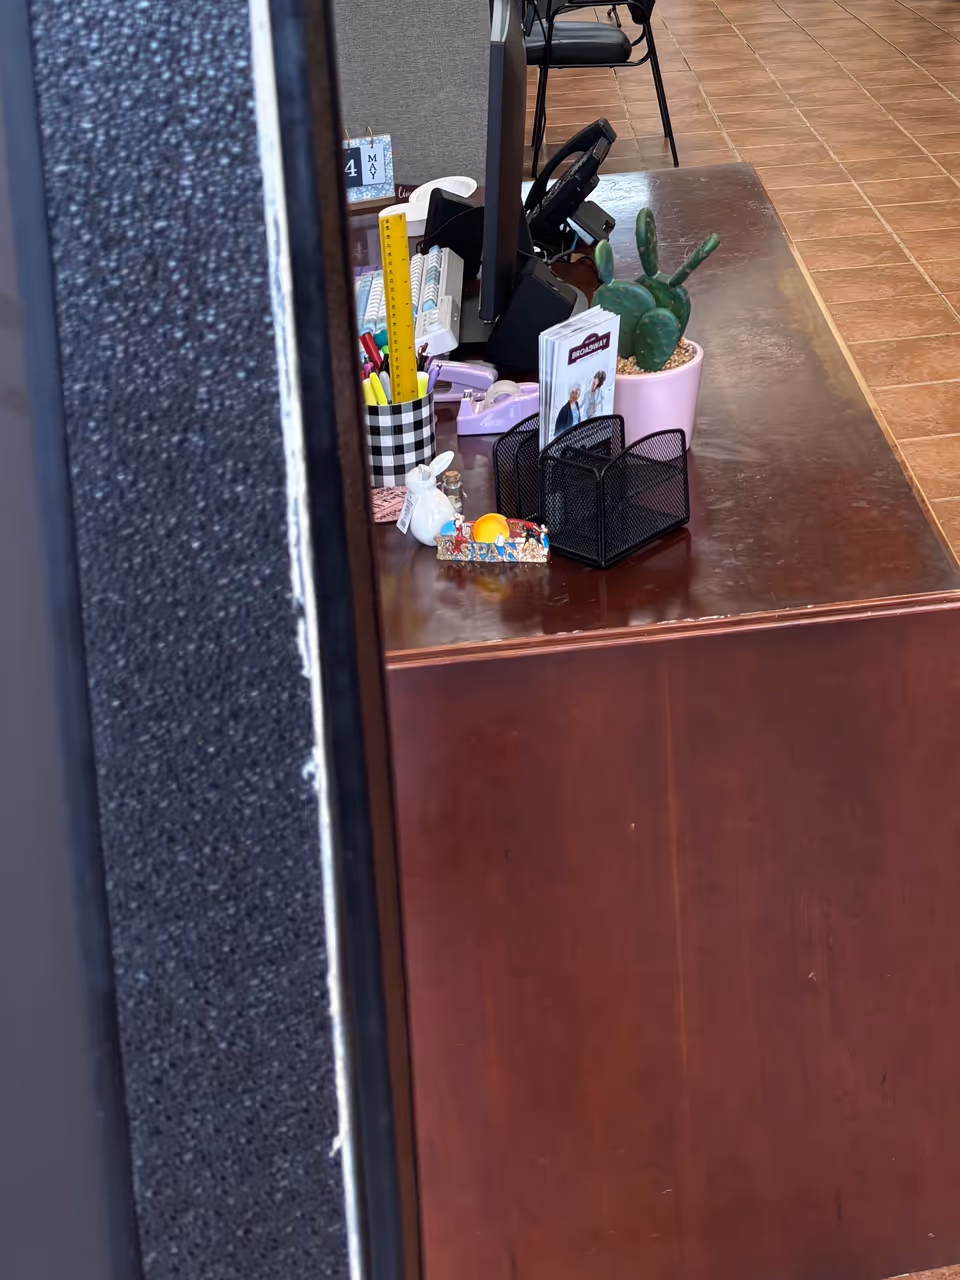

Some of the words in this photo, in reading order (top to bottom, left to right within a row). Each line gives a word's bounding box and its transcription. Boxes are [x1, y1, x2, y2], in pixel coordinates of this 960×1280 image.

[344, 159, 357, 177] 4
[368, 154, 377, 180] MAY
[572, 338, 607, 359] BROADWAY
